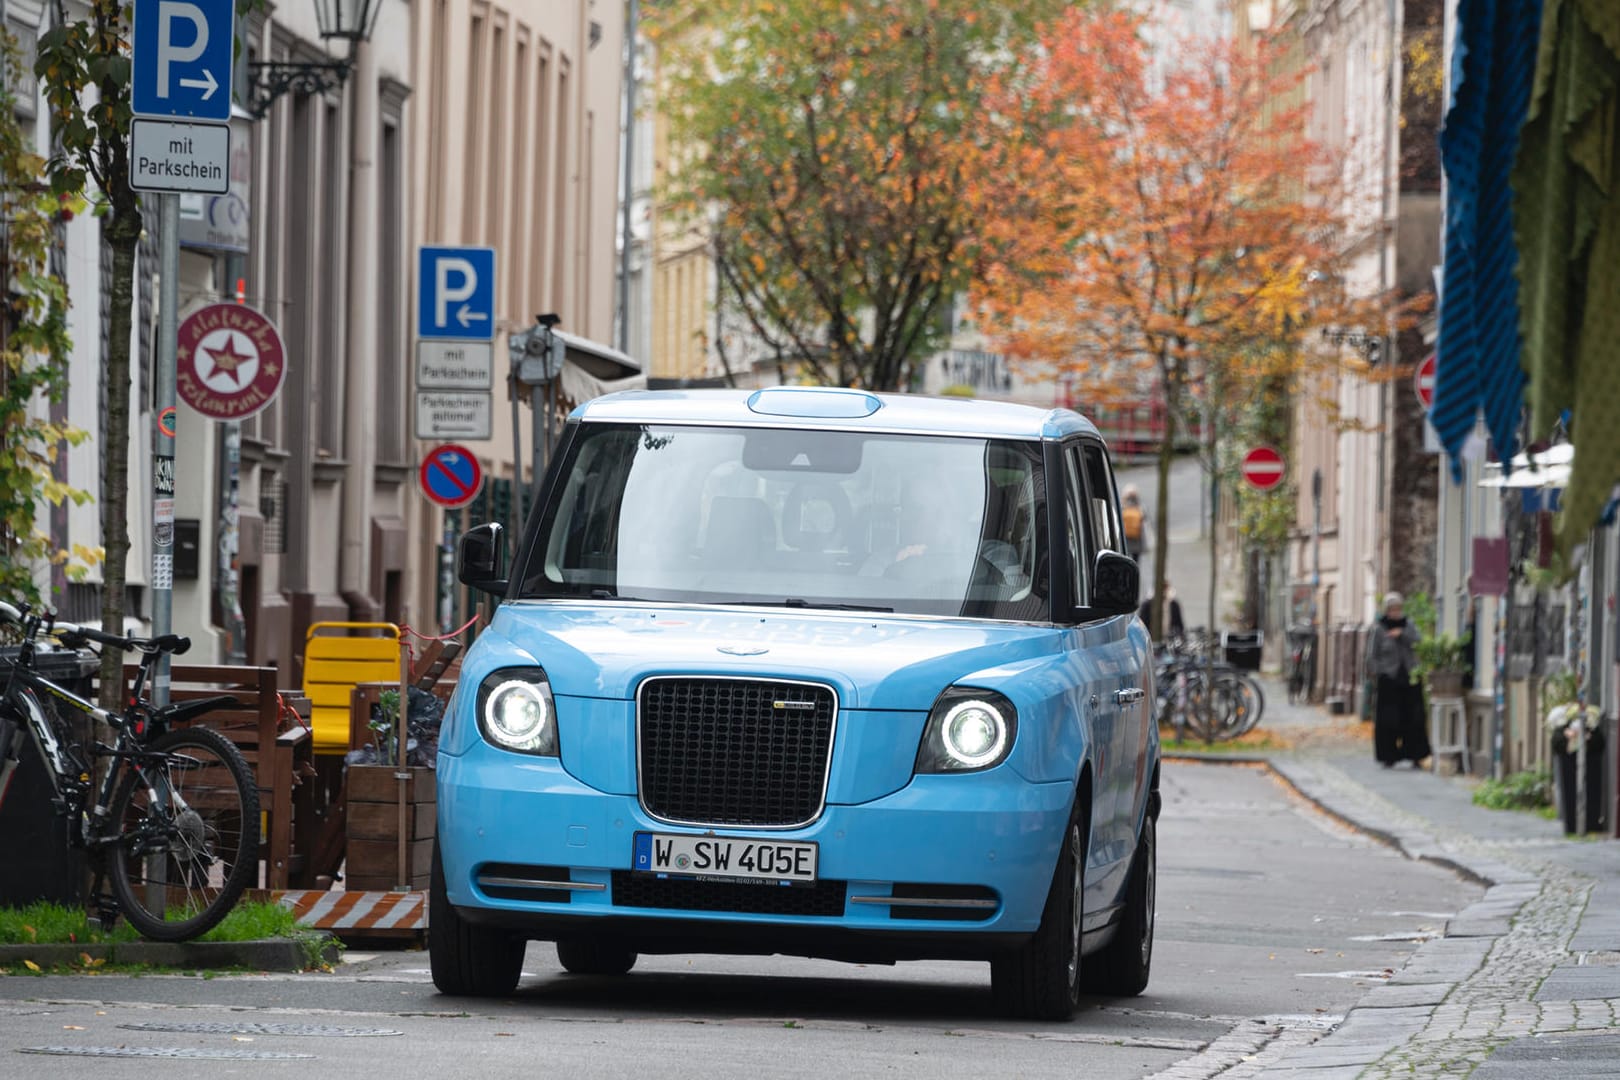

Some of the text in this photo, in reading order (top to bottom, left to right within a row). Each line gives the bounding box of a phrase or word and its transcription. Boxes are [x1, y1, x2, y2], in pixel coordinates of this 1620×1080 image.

[156, 1, 210, 99] P
[169, 137, 193, 155] mit
[139, 157, 222, 180] Parkschein
[434, 256, 478, 328] P
[444, 350, 465, 361] mit
[422, 364, 488, 379] Parkschein
[639, 854, 647, 864] D
[655, 839, 812, 876] W SW 405E
